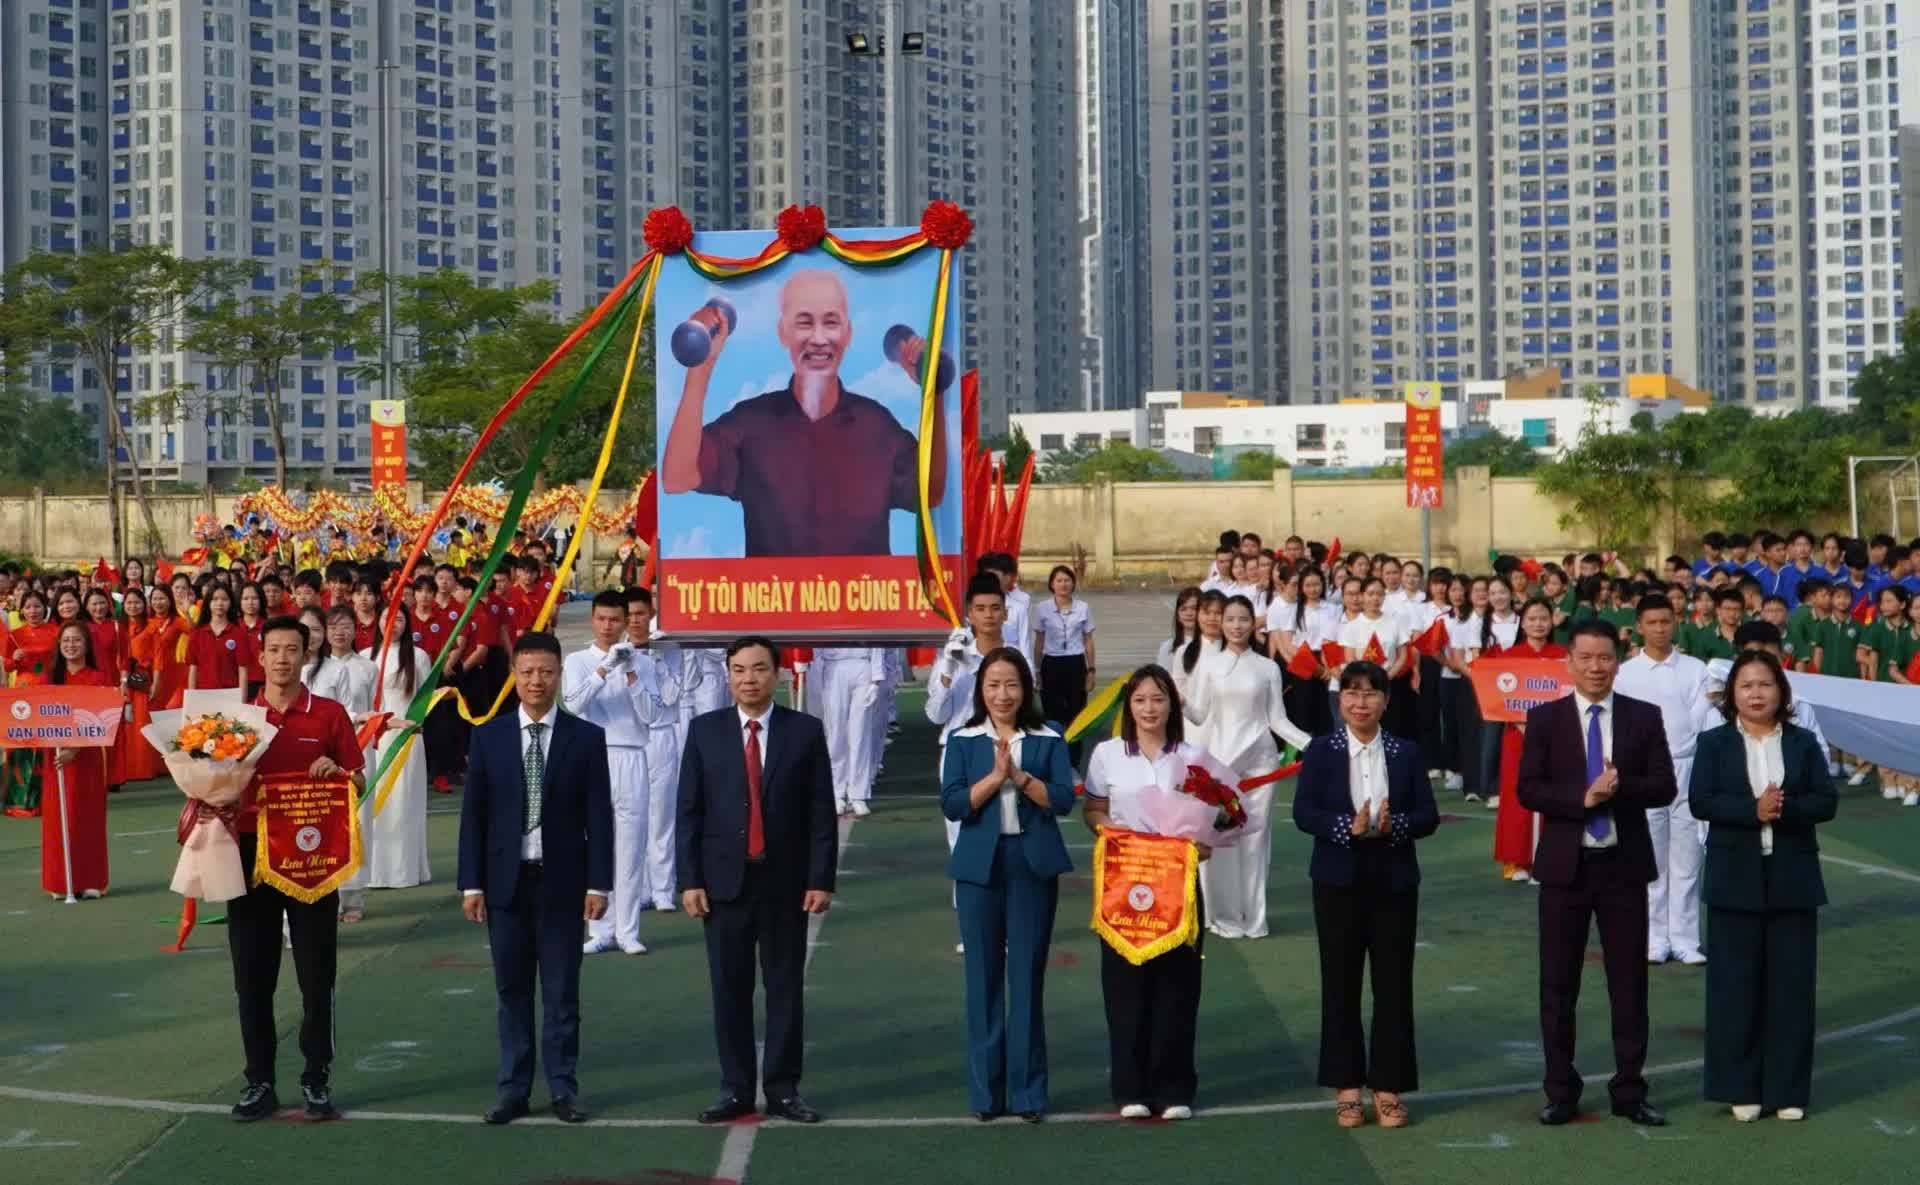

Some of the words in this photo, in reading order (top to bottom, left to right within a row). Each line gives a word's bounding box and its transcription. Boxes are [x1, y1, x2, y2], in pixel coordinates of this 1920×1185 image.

[708, 575, 737, 613] TÔI
[742, 574, 795, 613] NGÀY
[801, 573, 841, 613] NÀO
[846, 573, 901, 612] CŨNG
